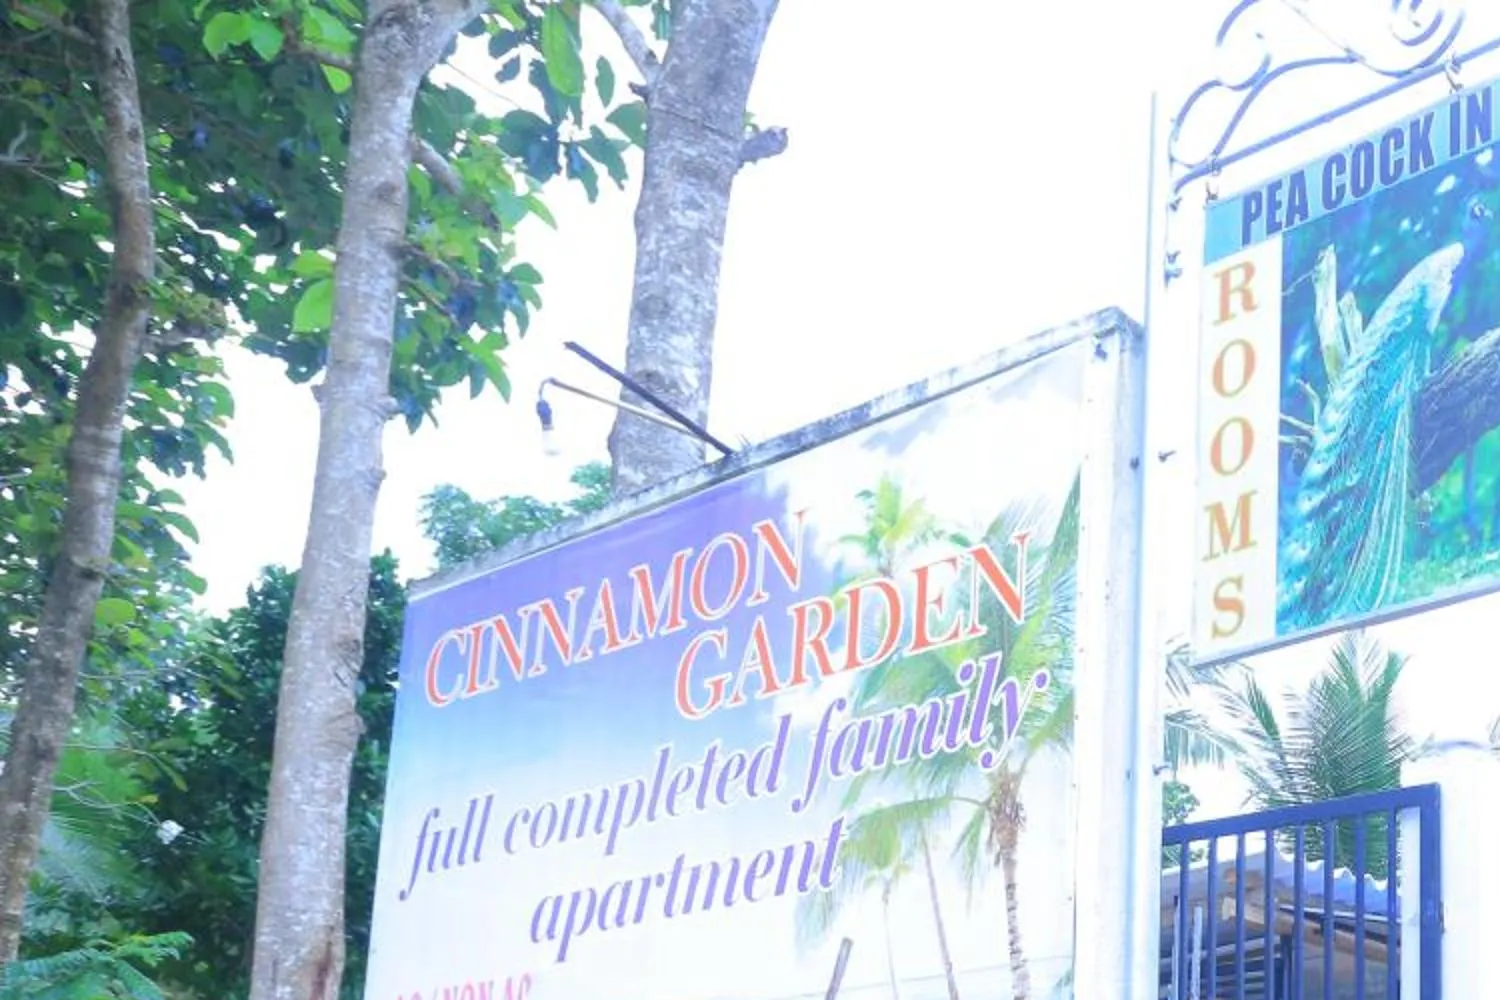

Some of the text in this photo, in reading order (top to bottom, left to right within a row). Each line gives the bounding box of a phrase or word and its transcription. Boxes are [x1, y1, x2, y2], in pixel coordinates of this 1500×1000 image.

[1242, 85, 1493, 247] PEA COCK IN
[1202, 259, 1258, 640] ROOMS
[426, 511, 803, 706] CINNAMON
[674, 532, 1030, 719] GARDEN
[399, 656, 1049, 901] full completed family
[528, 816, 846, 963] apartment
